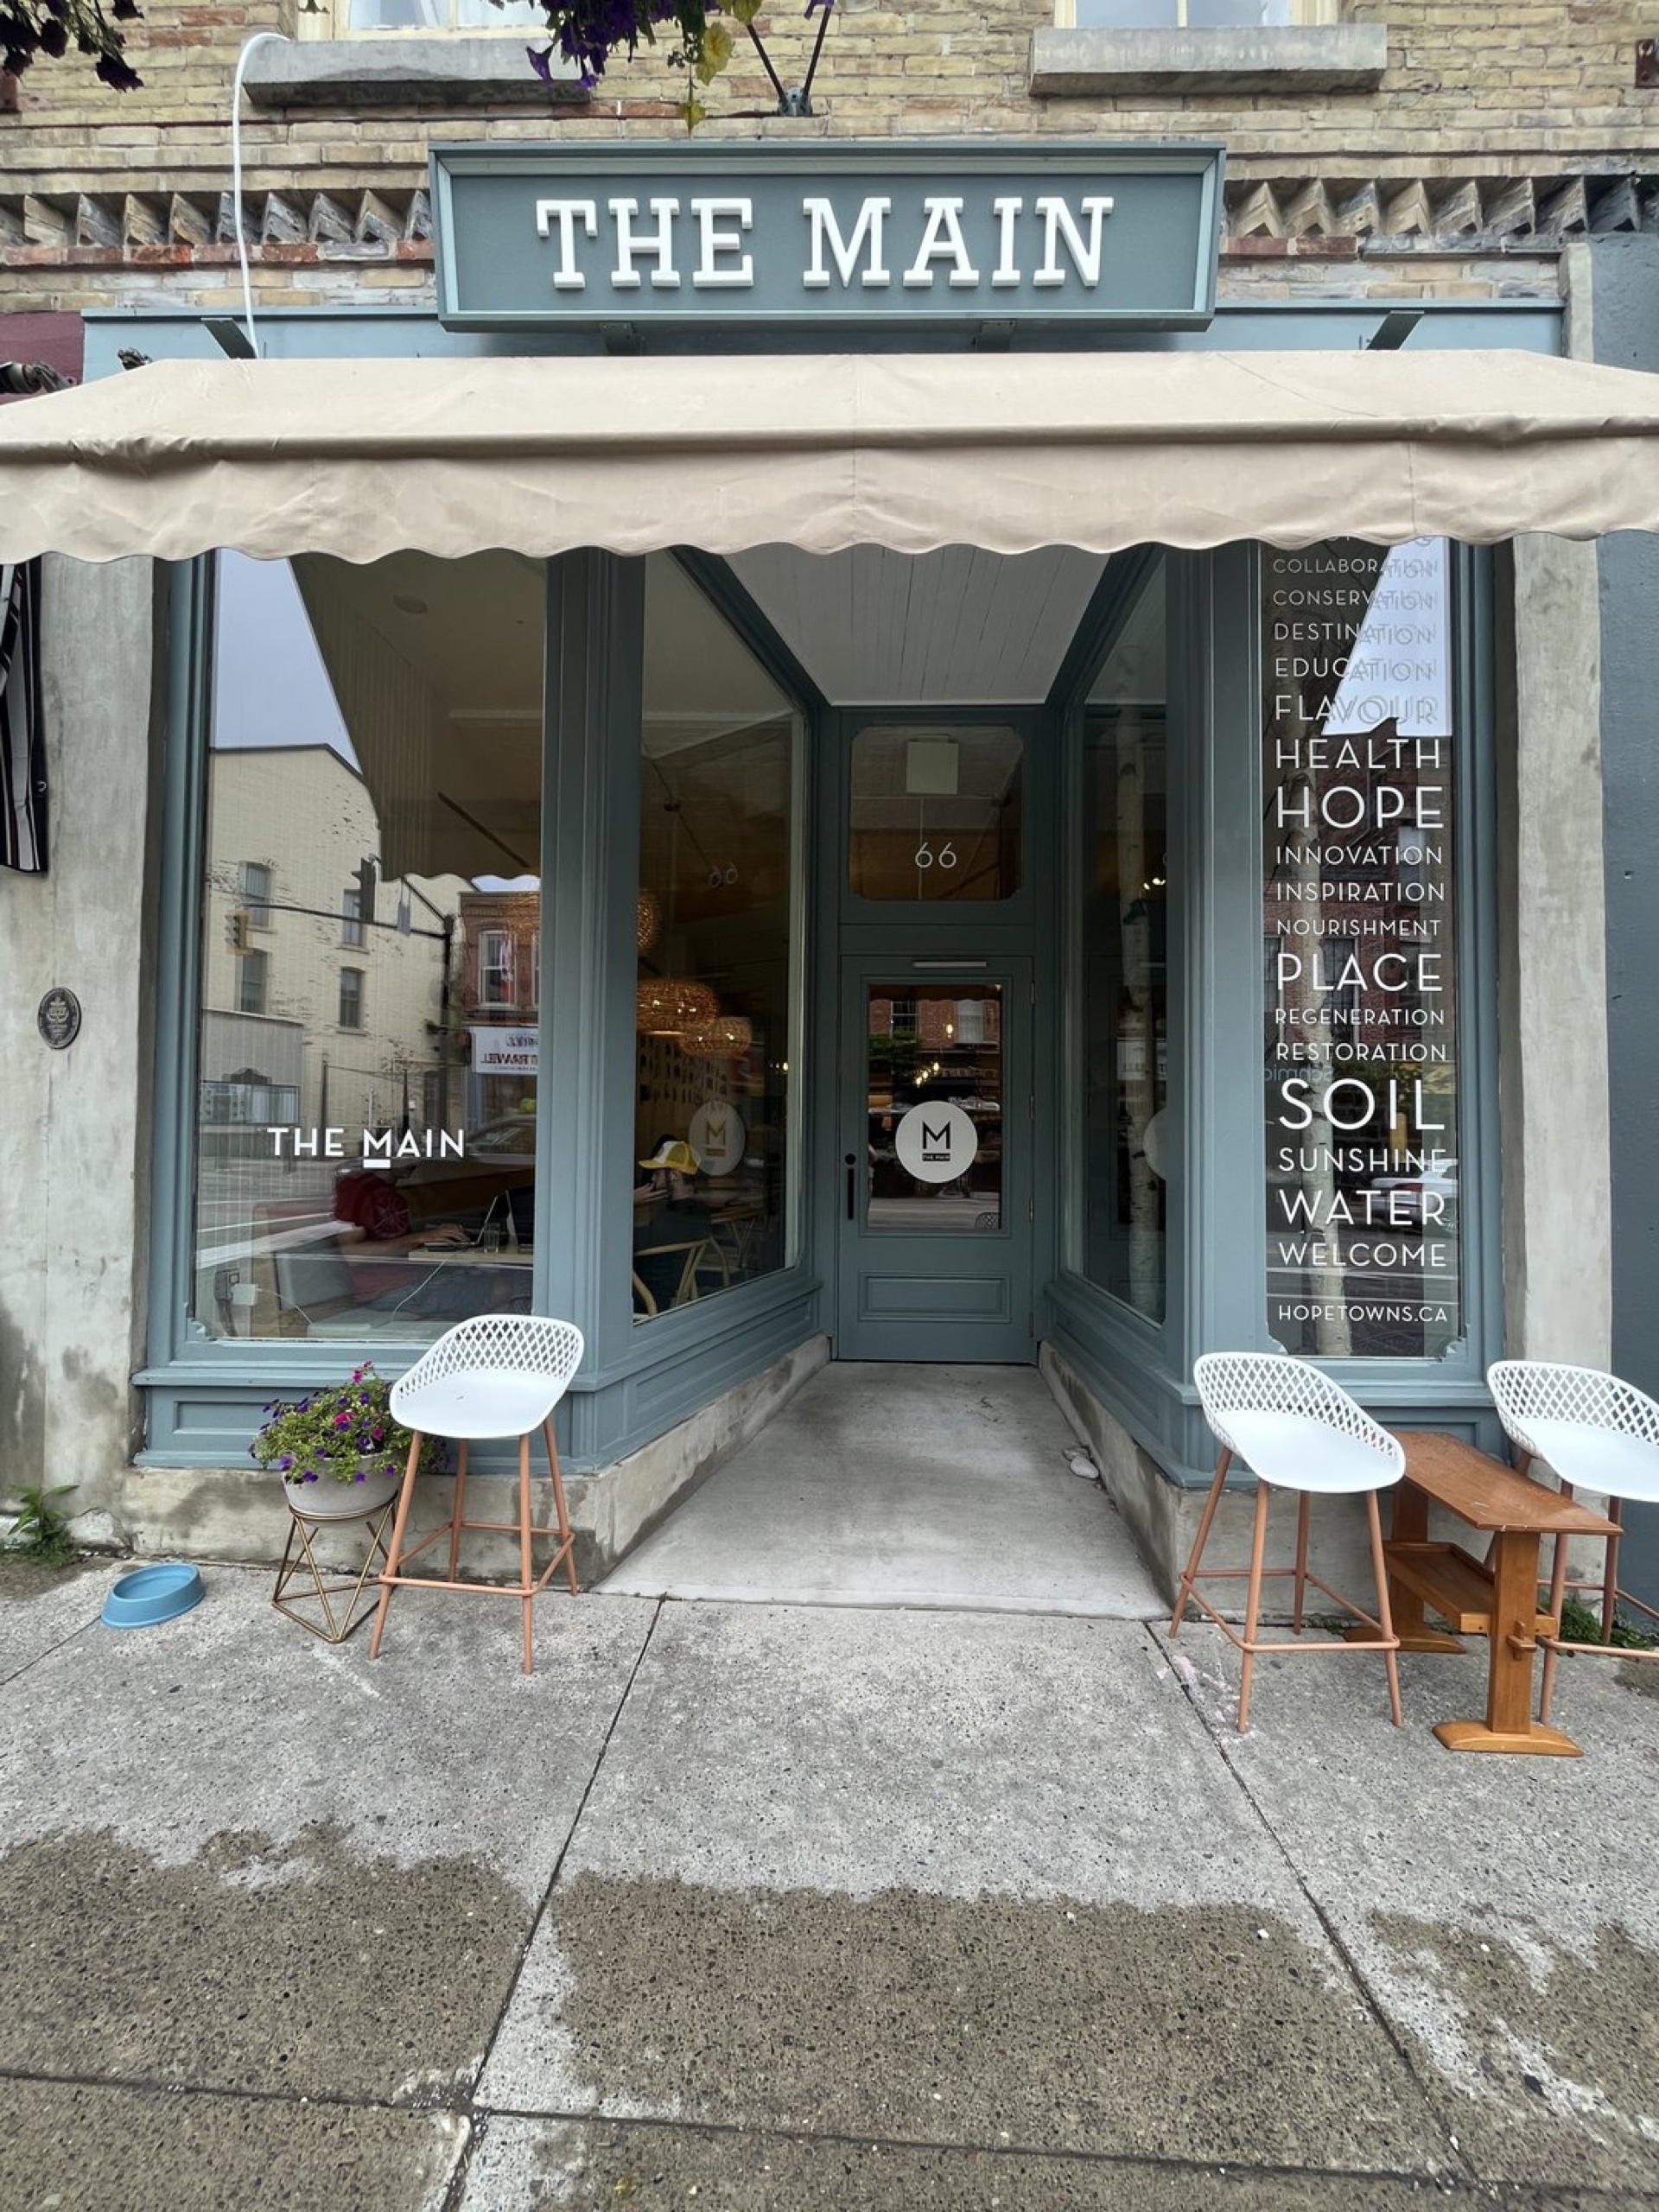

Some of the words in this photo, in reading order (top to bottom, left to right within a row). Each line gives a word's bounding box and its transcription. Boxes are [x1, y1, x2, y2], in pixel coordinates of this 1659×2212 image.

[537, 197, 755, 290] THE
[802, 195, 1116, 289] MAIN
[1273, 558, 1438, 574] COLLABORATION
[1273, 589, 1437, 607] CONSERVATION
[1274, 622, 1436, 641] DESTINATION
[1275, 657, 1436, 677] EDUCATION
[1275, 695, 1438, 721] FLAVOUR
[1276, 738, 1440, 769] HEALTH
[1277, 785, 1444, 829] HOPE
[915, 842, 957, 868] 66
[1276, 846, 1442, 865] INNOVATION
[1276, 882, 1445, 902] INSPIRATION
[1276, 919, 1441, 937] NOURISHMENT
[1277, 953, 1443, 992] PLACE
[1275, 1008, 1445, 1026] REGENERATION
[1275, 1042, 1446, 1061] RESTORATION
[1278, 1077, 1445, 1130] SOIL
[267, 1128, 345, 1156] THE
[363, 1128, 465, 1158] MAIN
[922, 1120, 951, 1150] M
[1278, 1147, 1446, 1172] SUNSHINE
[1278, 1189, 1446, 1225] WATER
[1278, 1242, 1446, 1267] WELCOME
[1278, 1305, 1448, 1322] HOPETOWNS.CA
